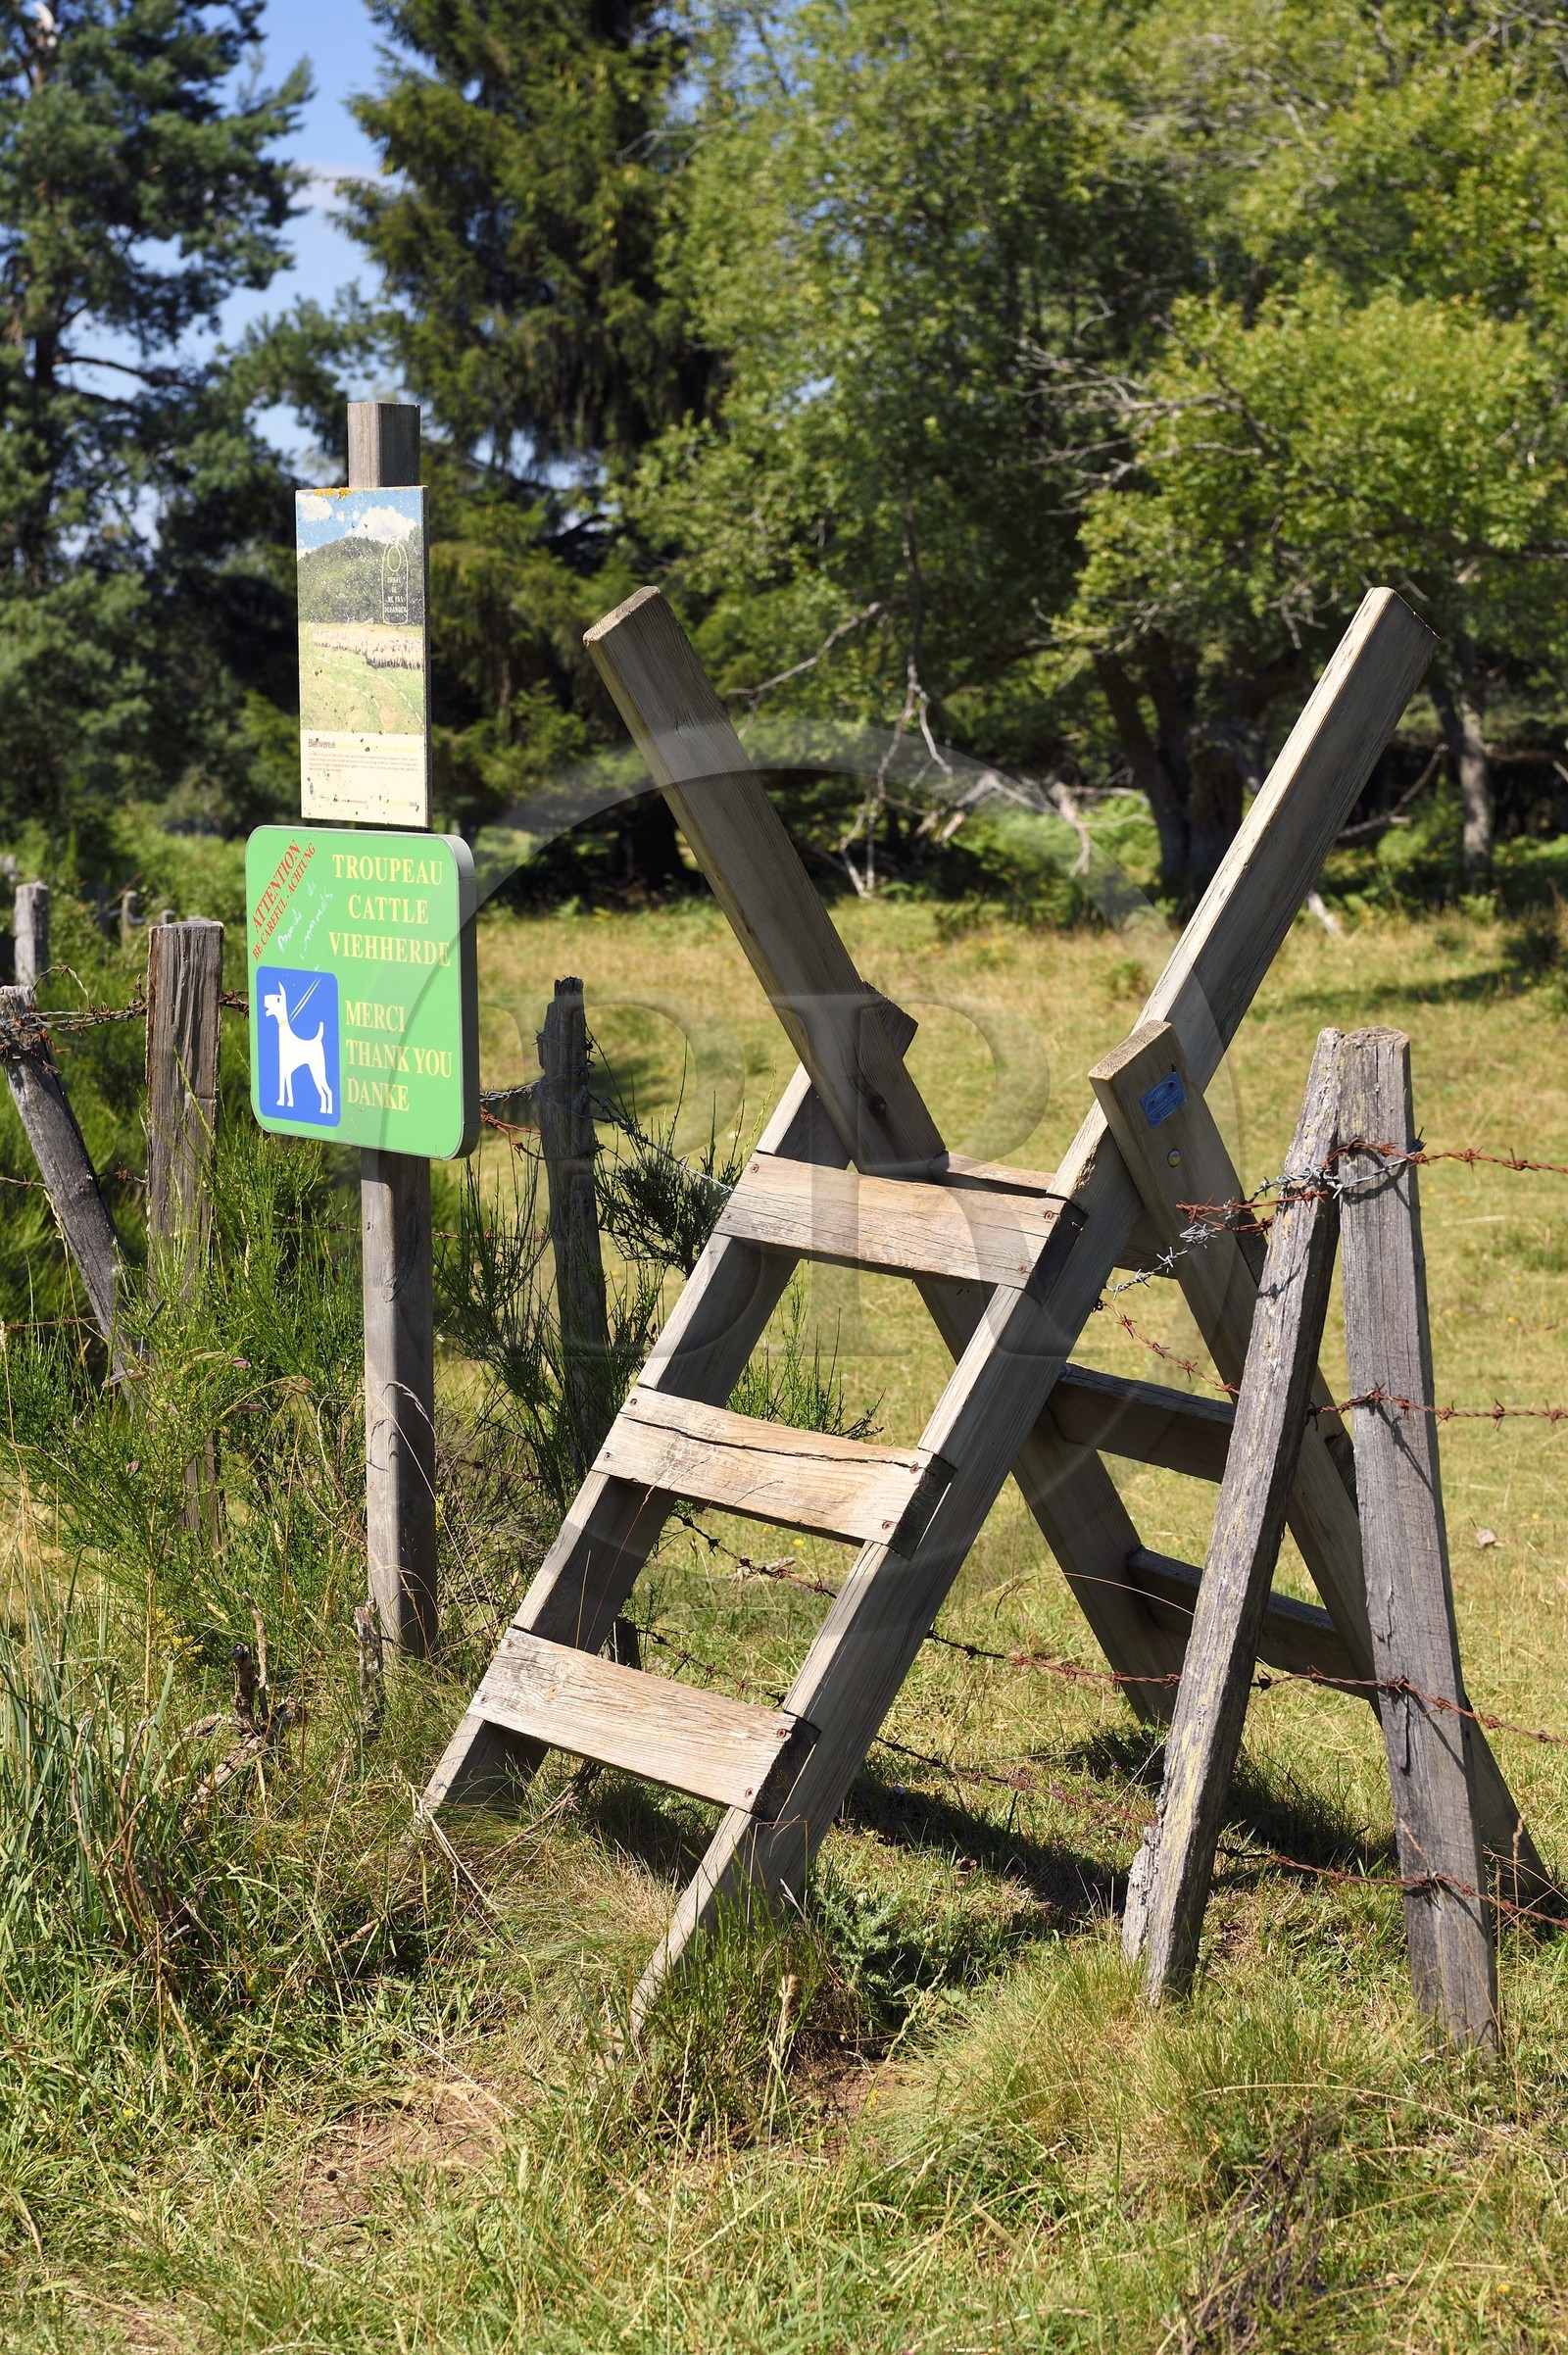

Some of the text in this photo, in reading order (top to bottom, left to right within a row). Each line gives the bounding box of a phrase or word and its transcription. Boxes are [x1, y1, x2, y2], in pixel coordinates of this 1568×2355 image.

[252, 839, 301, 934] ATTENTION
[331, 854, 443, 886] TROUPEAU
[252, 942, 264, 960] BE
[260, 899, 288, 946] CAREFUL
[287, 843, 316, 897] ACHTUNG
[348, 894, 429, 925] CATTLE
[328, 931, 451, 967] VIEHHERDE
[345, 1000, 407, 1033] MERCI
[345, 1039, 453, 1078] THANK YOU
[347, 1077, 410, 1111] DANKE
